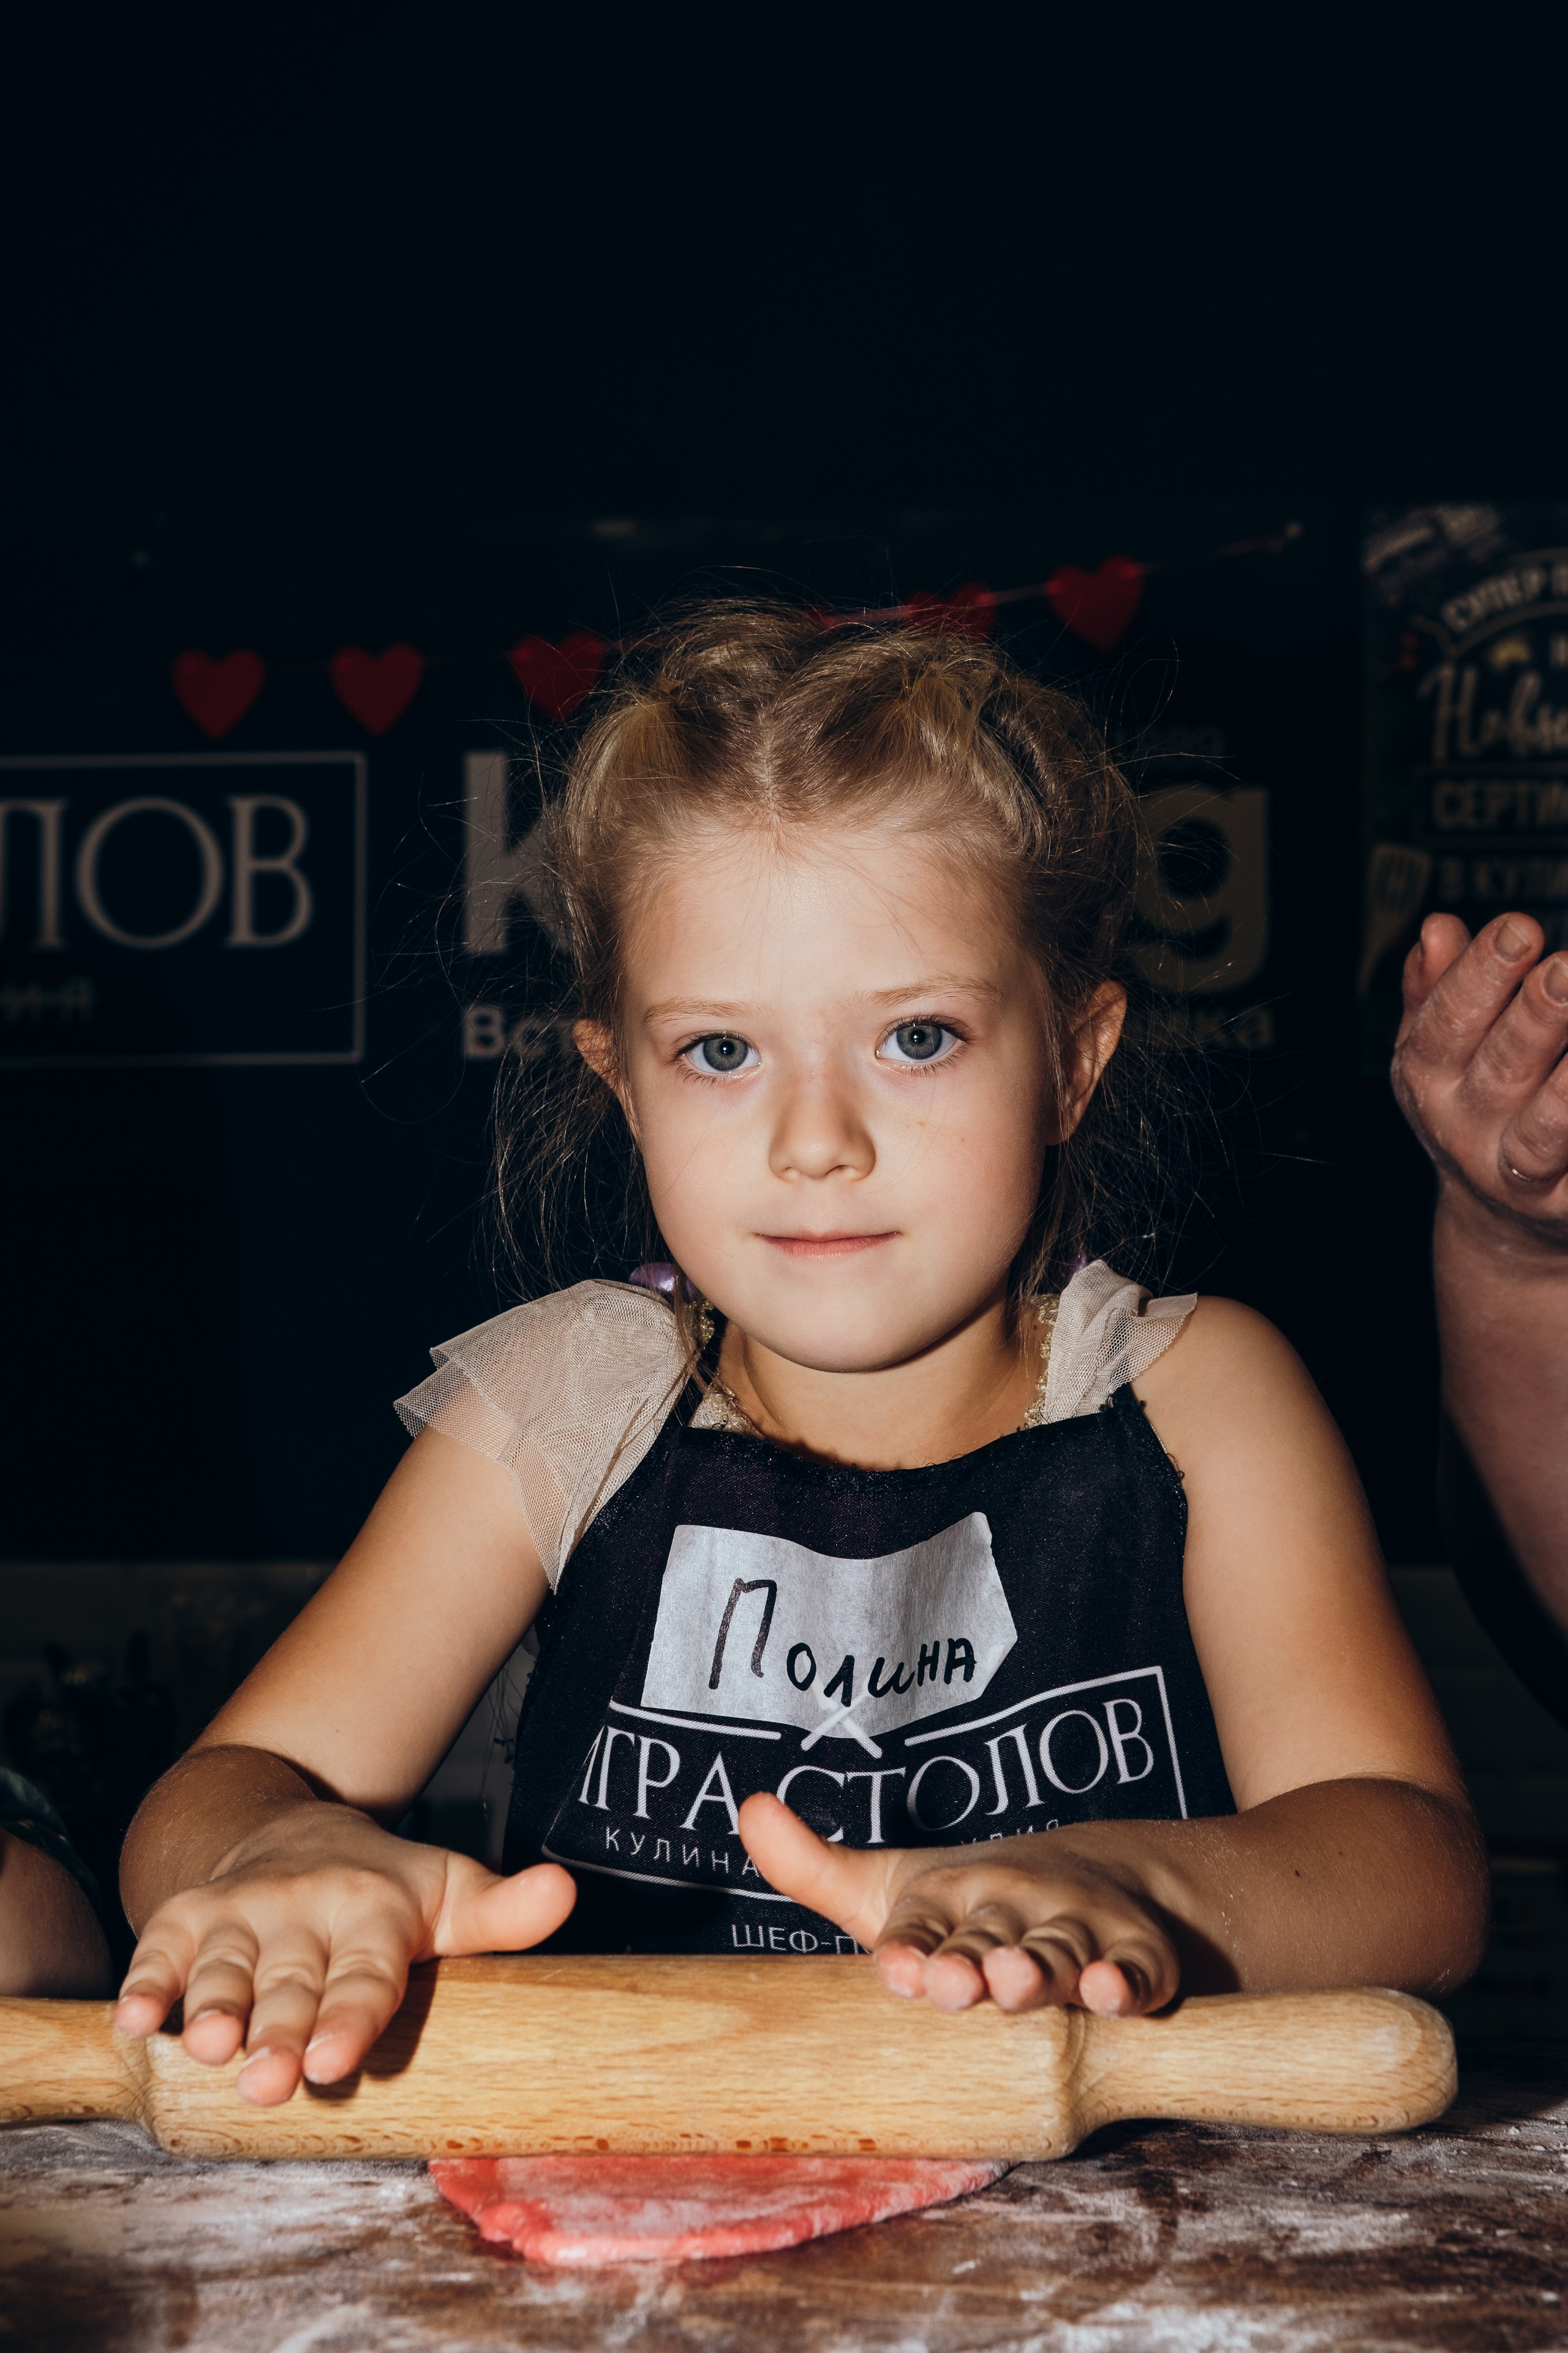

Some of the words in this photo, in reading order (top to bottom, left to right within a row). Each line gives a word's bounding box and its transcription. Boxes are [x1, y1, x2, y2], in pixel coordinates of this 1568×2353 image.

[775, 1698, 1155, 1844] СТОЛОВ
[605, 1826, 761, 1877] КУЛИНА
[731, 1924, 871, 1954] ШЕФ-П
